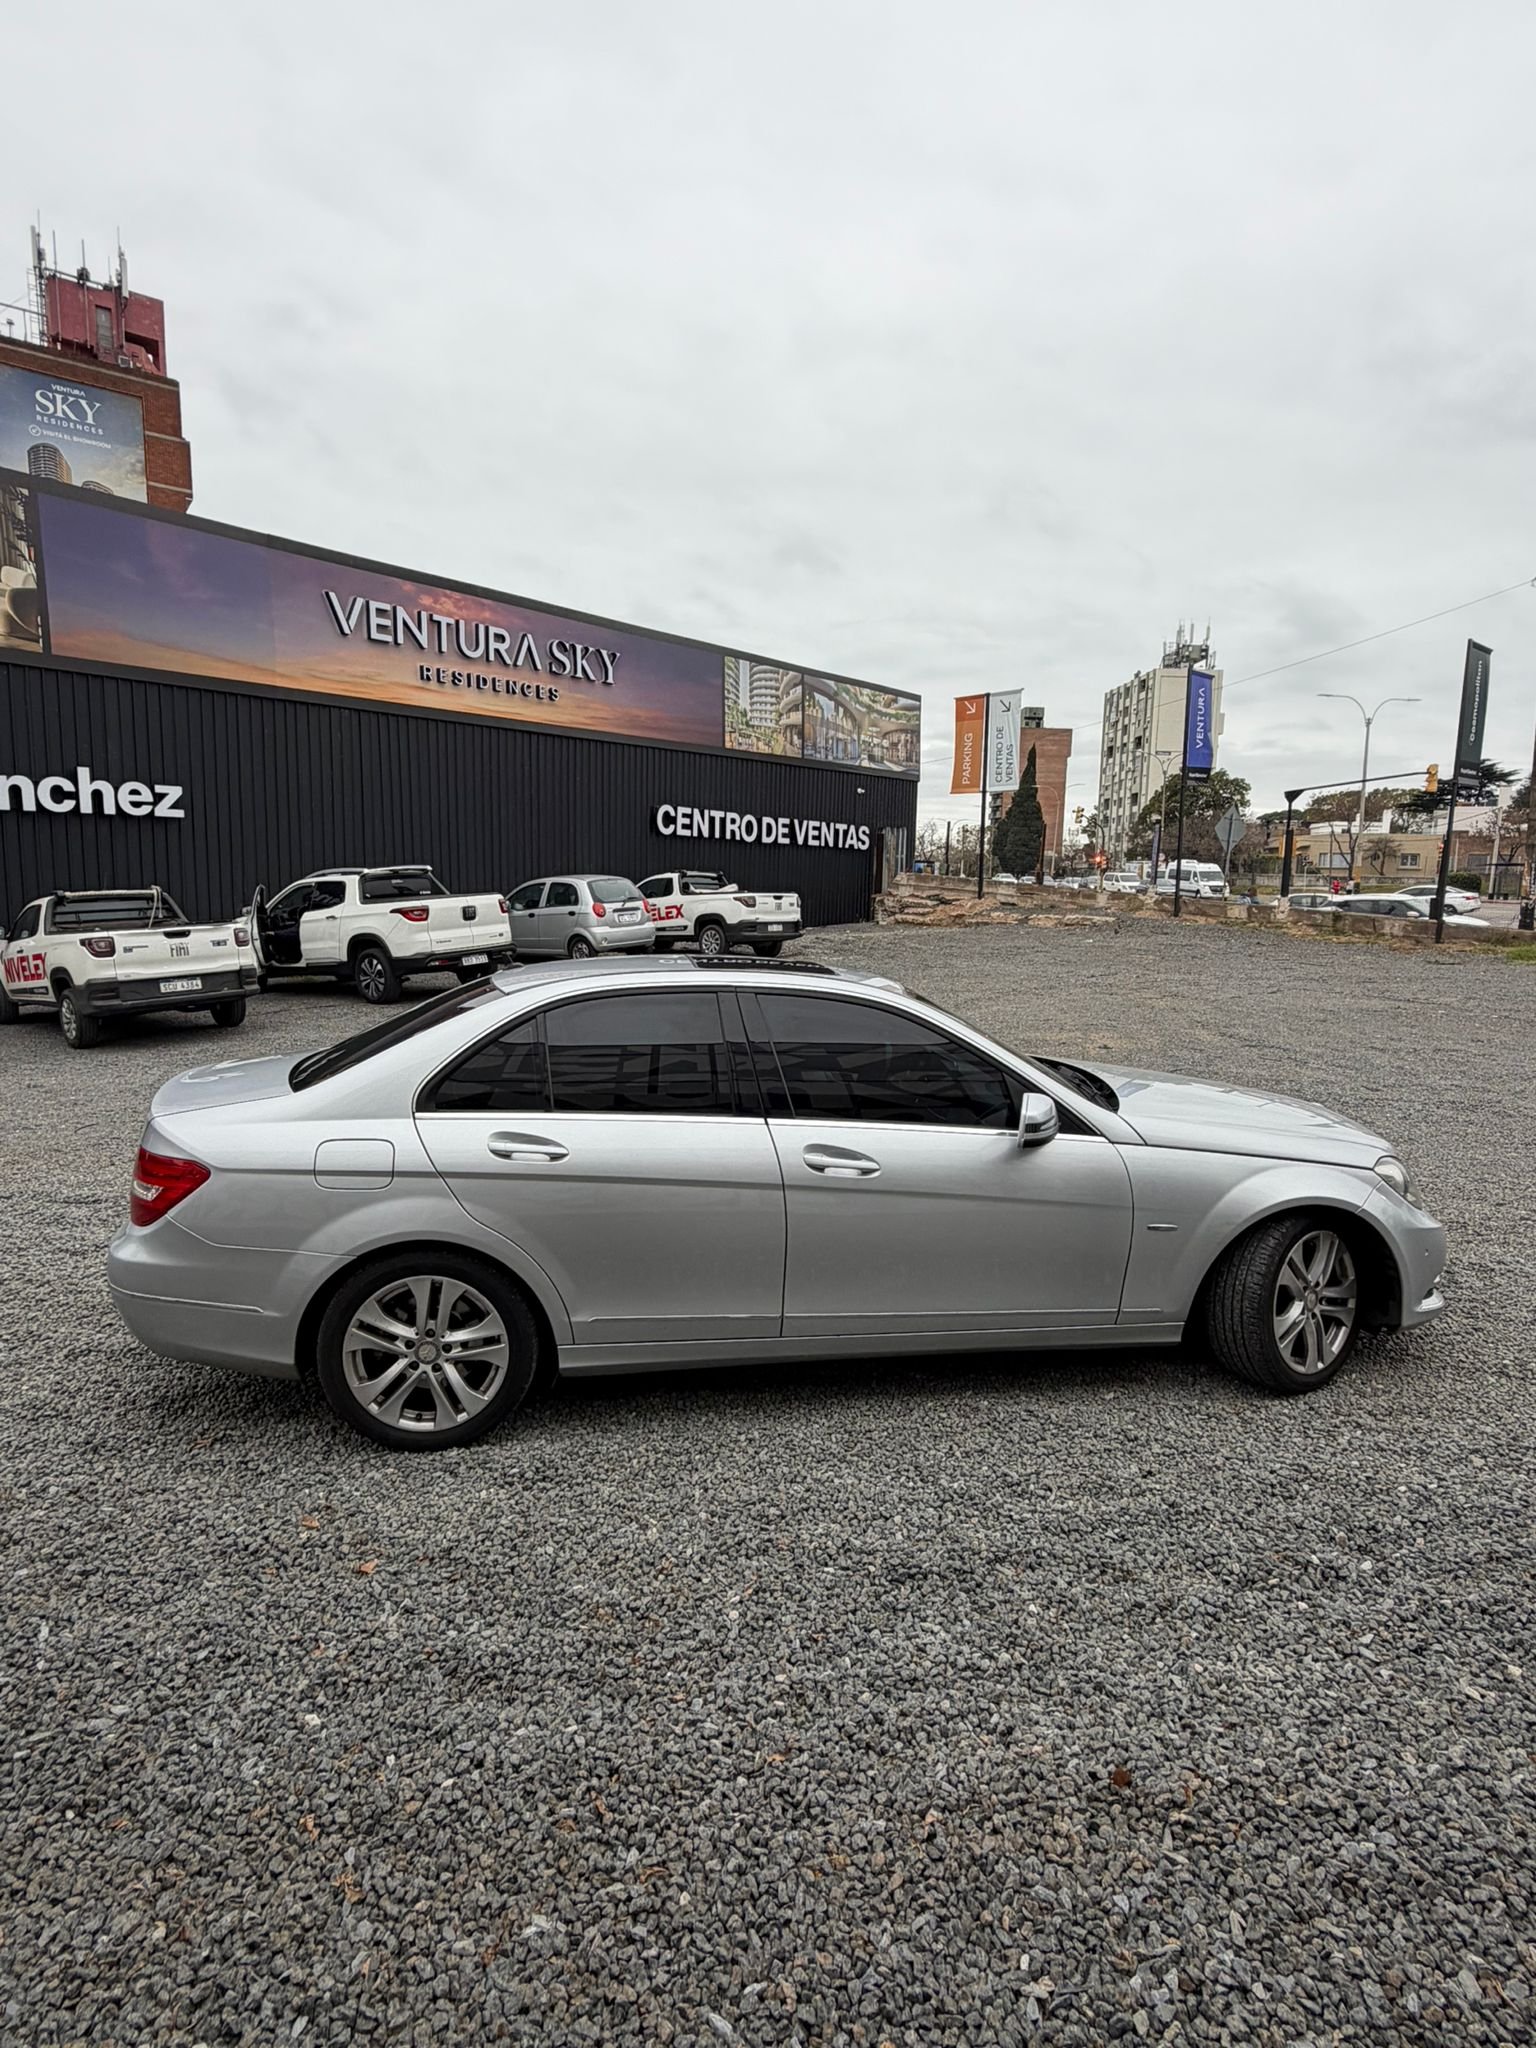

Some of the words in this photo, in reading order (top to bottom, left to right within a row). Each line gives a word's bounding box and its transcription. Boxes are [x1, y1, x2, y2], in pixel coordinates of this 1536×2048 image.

[35, 389, 102, 425] SKY
[52, 384, 86, 397] VENTURA
[36, 415, 104, 435] RESIDENCES
[322, 590, 542, 671] VENTURA
[548, 639, 621, 685] SKY
[419, 664, 560, 701] RESIDENCES
[996, 726, 1004, 740] DE
[1196, 687, 1205, 748] VENTURA
[962, 732, 973, 784] PARKING
[995, 741, 1004, 783] CENTRO
[1005, 743, 1014, 783] VENTAS
[0, 766, 185, 818] nchez
[656, 804, 758, 843] CENTRO
[761, 817, 790, 844] DE
[794, 818, 870, 850] VENTAS
[4, 952, 48, 983] NIVELEX
[170, 942, 190, 957] FIAT
